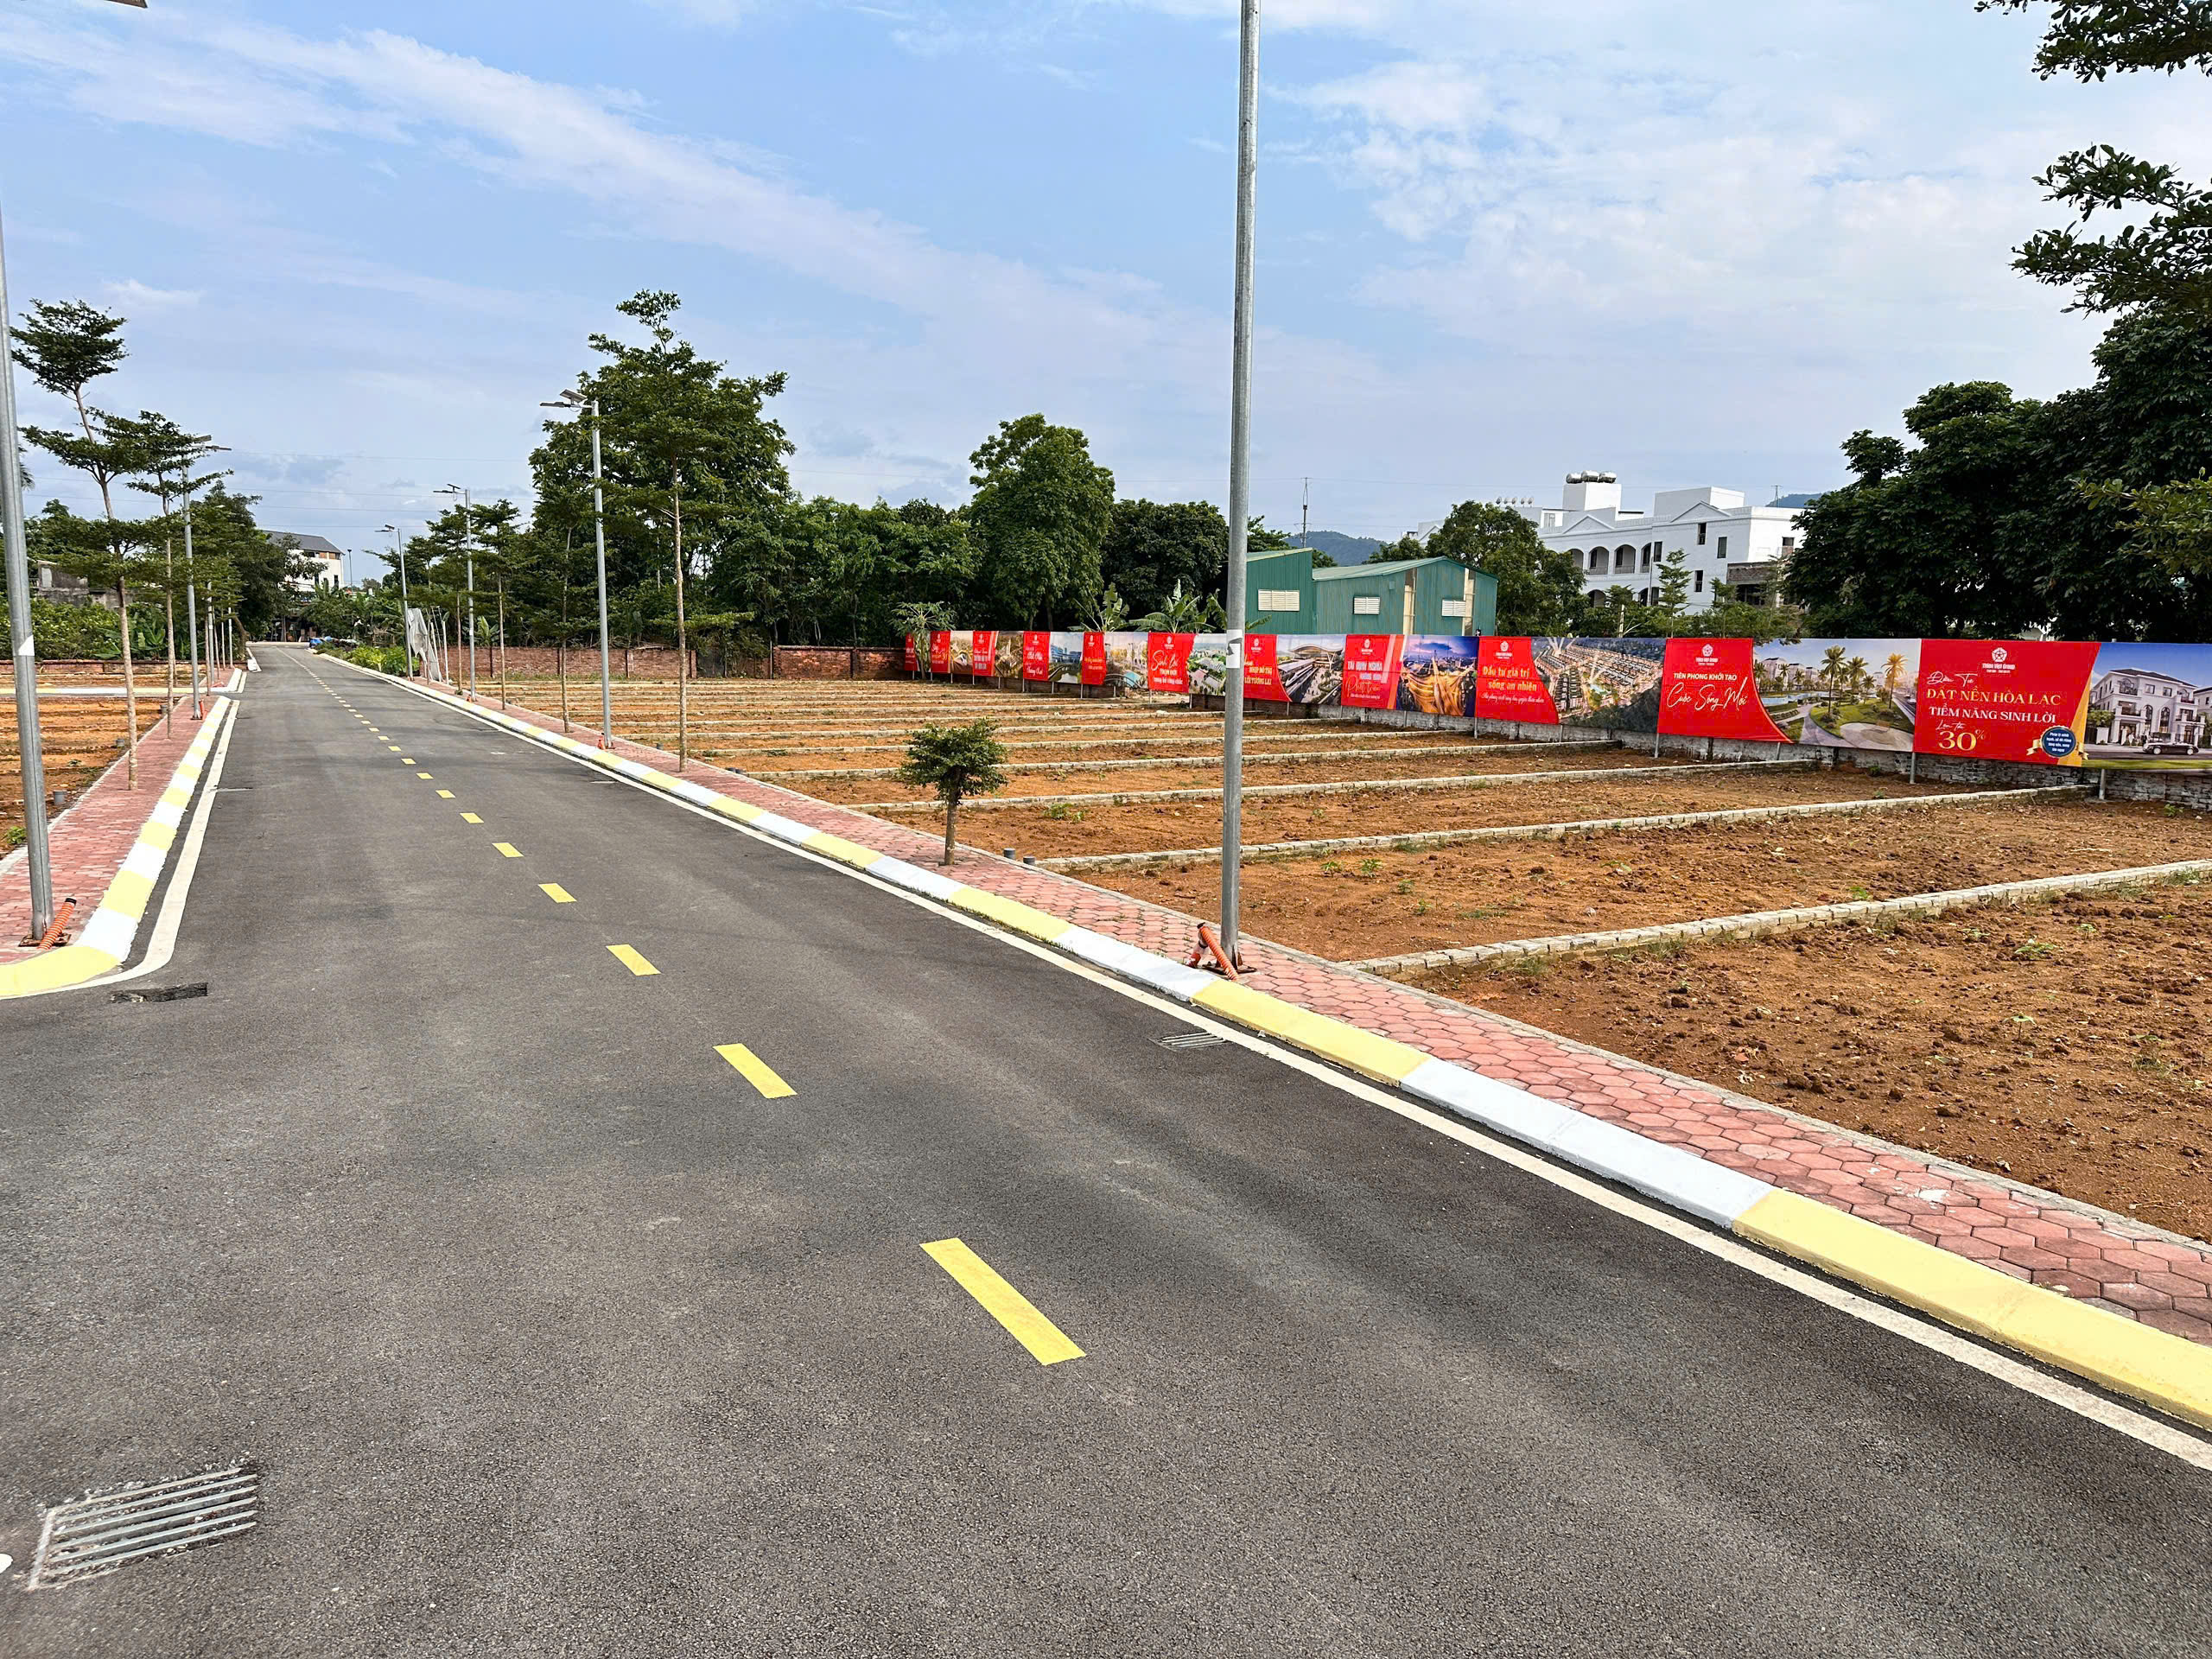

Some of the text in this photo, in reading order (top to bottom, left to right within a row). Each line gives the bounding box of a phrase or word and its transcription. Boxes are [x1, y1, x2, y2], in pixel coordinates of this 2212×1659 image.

[1488, 678, 1505, 692] sống
[1517, 680, 1537, 692] nhiên
[1926, 685, 2062, 708] ĐẤT NỀN HÒA LẠC
[1694, 683, 1724, 712] Sống
[1929, 702, 2056, 724] TIỀM NĂNG SINH LỜI
[1938, 729, 1986, 752] 30%
